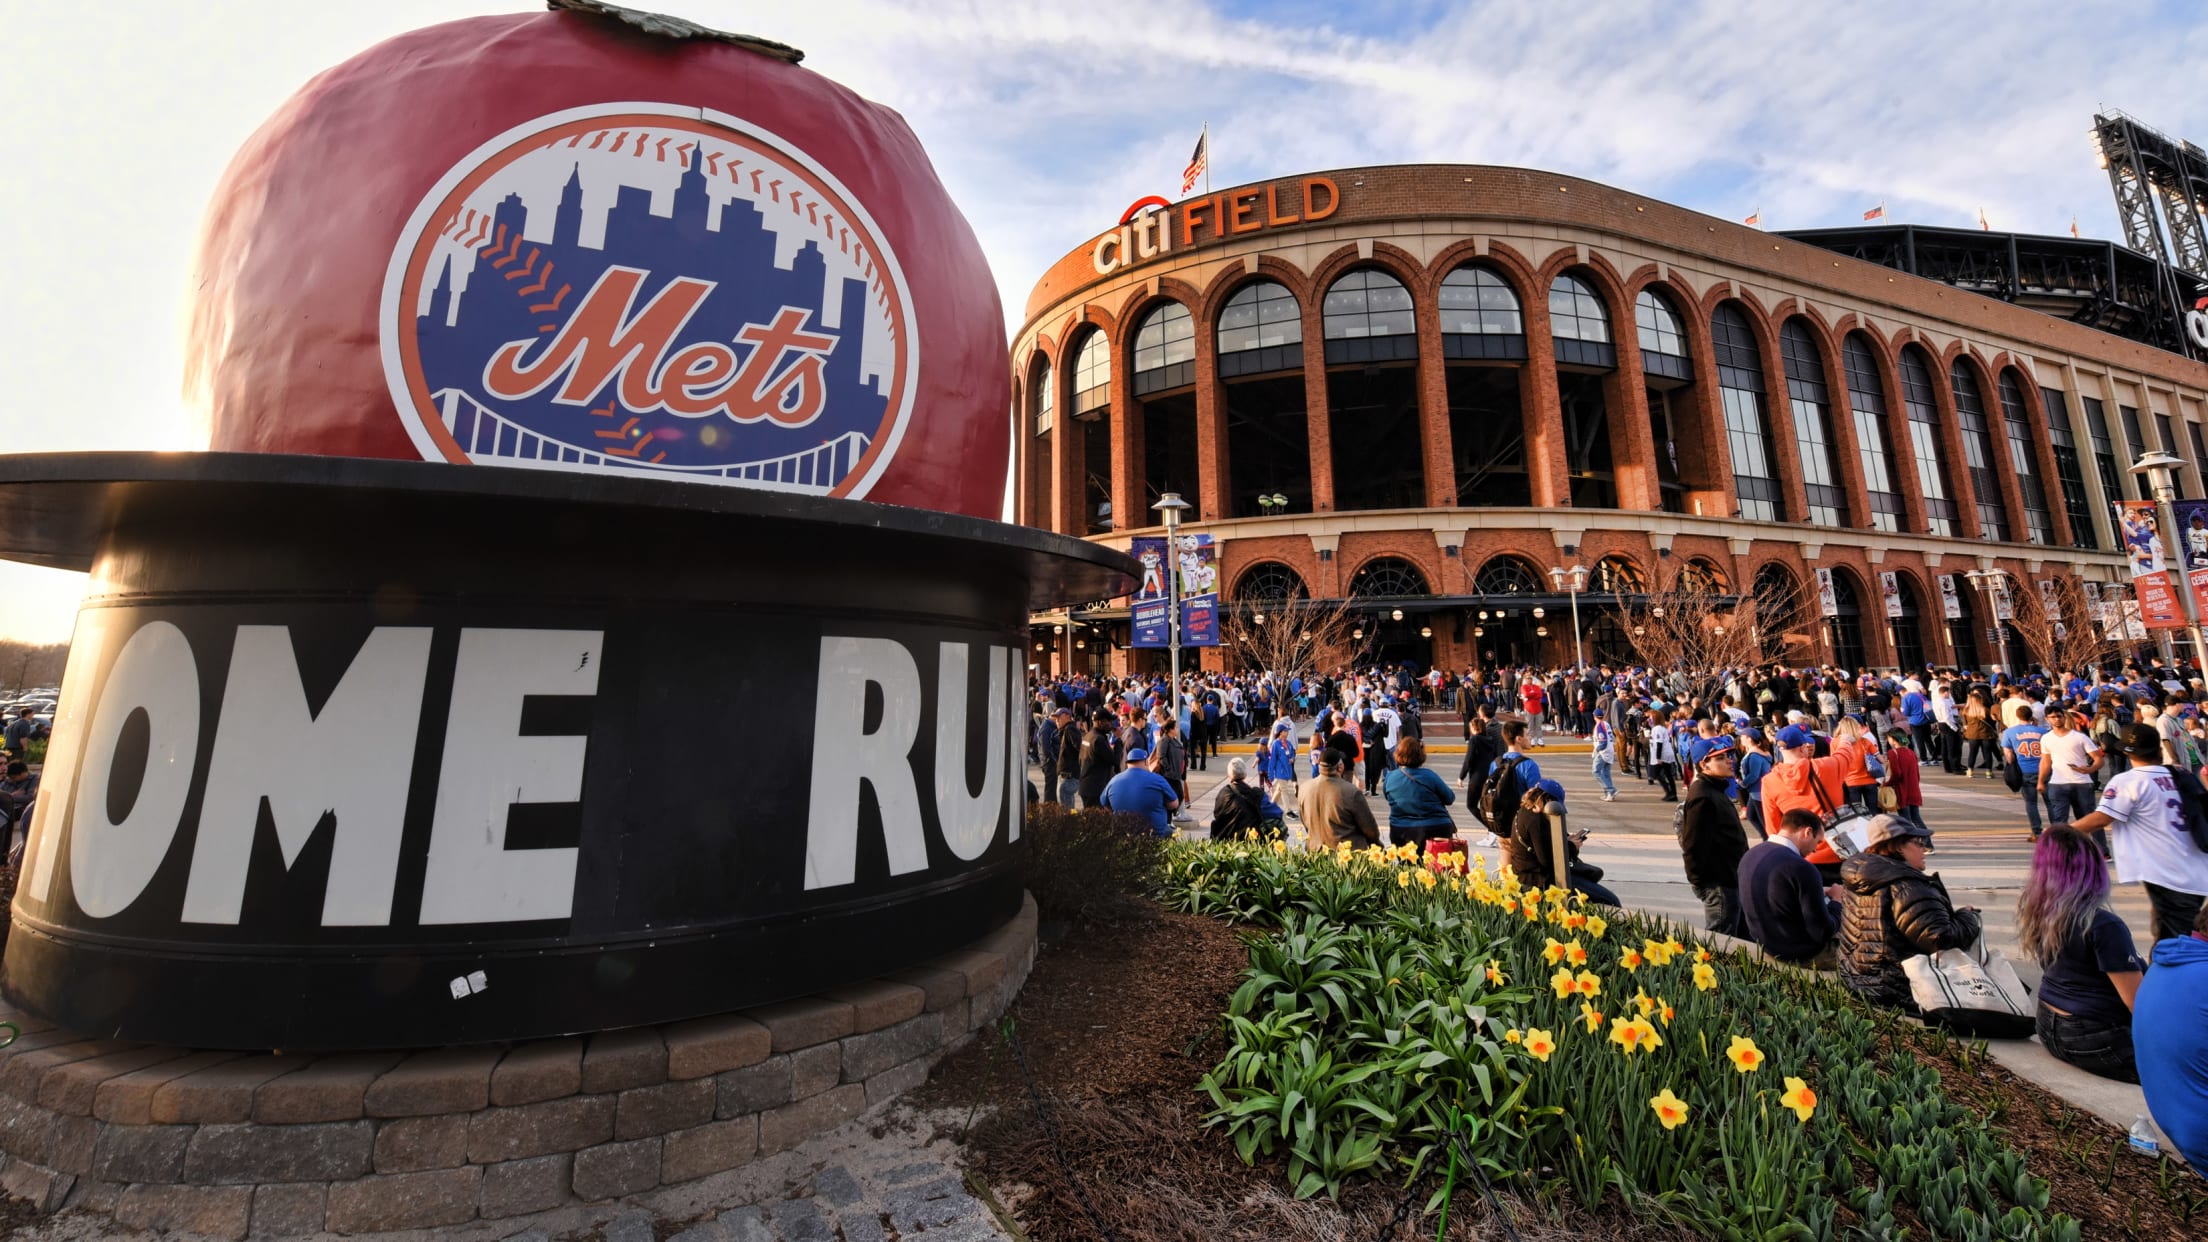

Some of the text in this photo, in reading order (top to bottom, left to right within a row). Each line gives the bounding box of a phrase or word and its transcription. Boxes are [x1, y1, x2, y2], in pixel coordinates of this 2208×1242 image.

[1092, 177, 1340, 275] citi FIELD
[482, 264, 840, 429] Mets
[2017, 741, 2042, 758] 48
